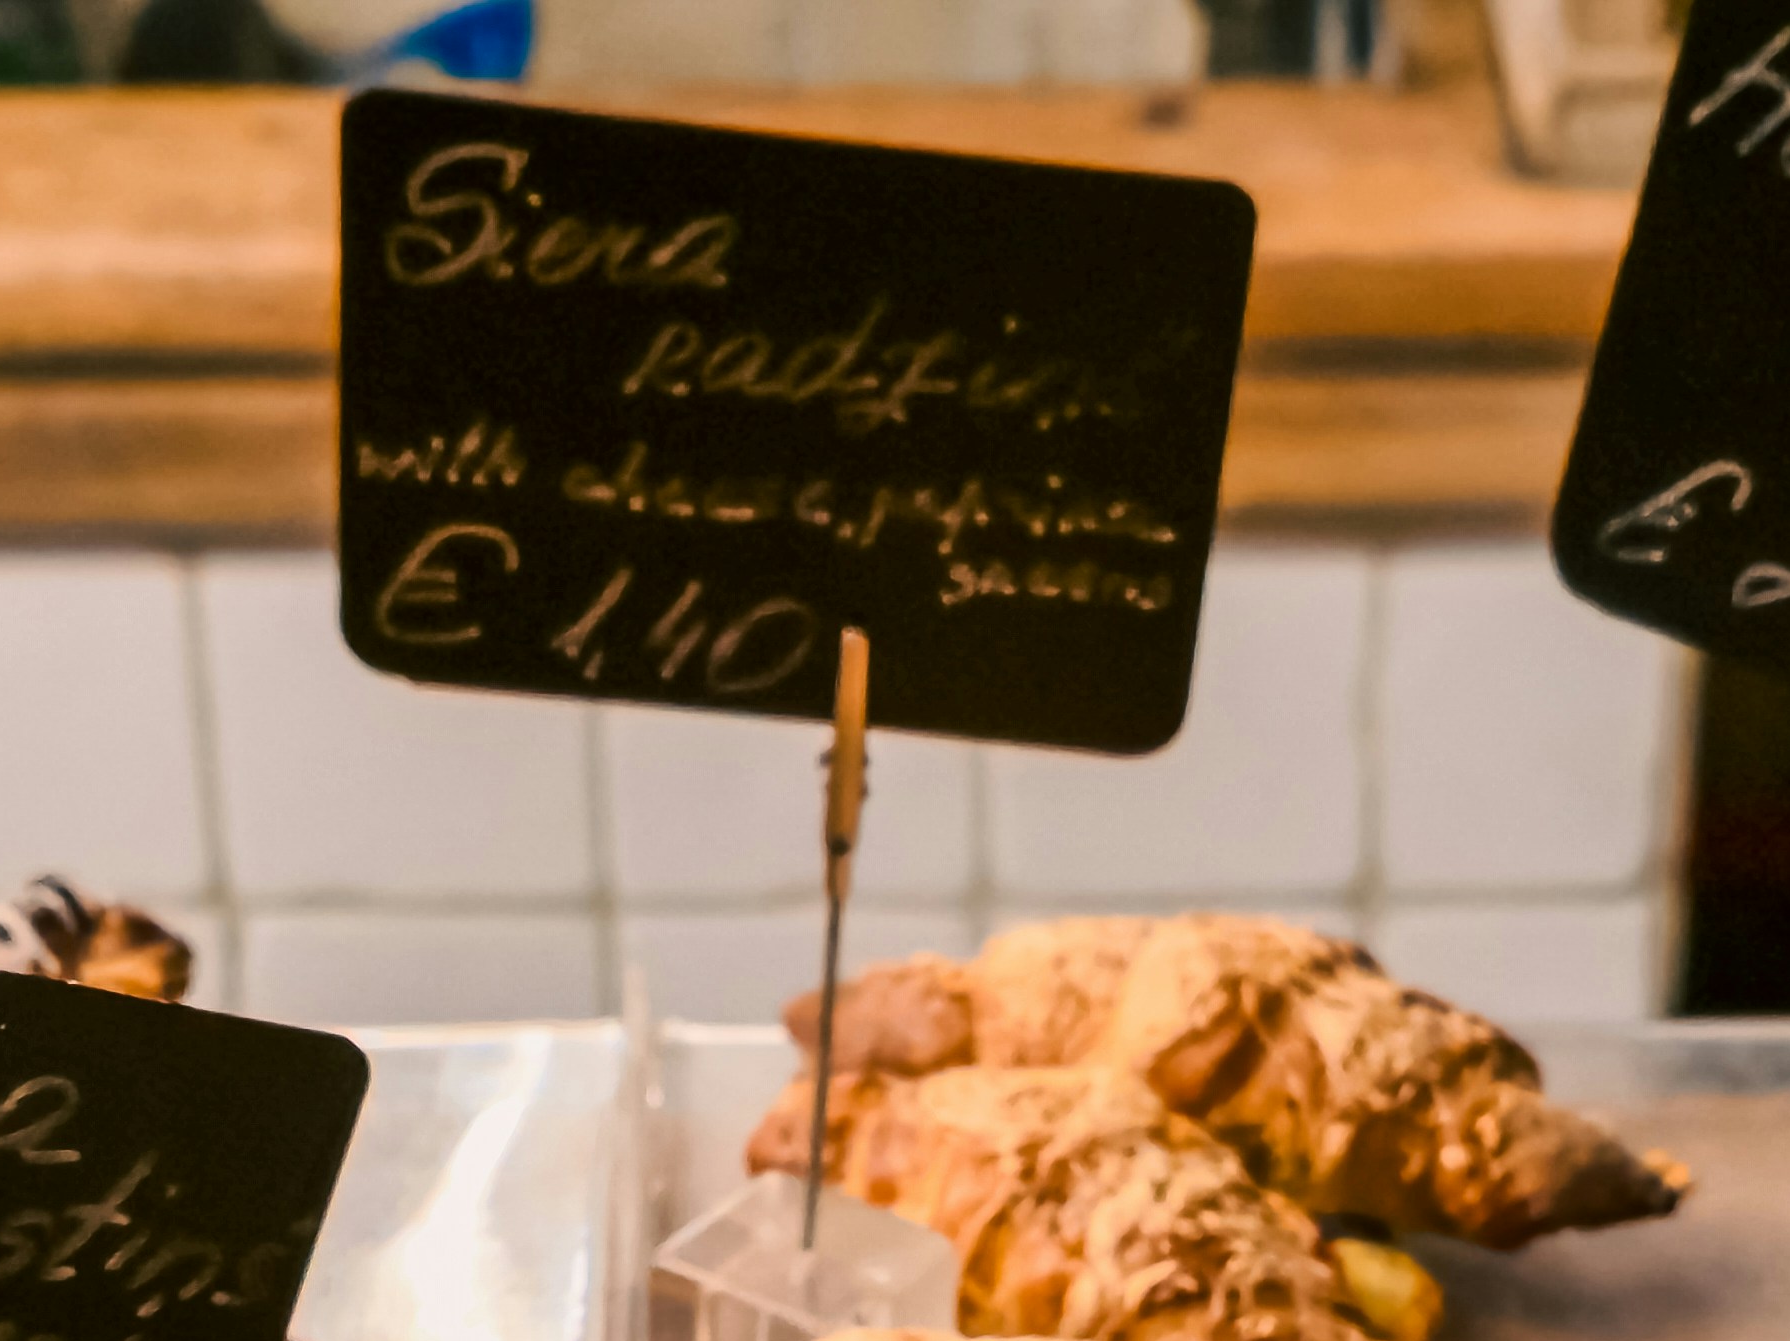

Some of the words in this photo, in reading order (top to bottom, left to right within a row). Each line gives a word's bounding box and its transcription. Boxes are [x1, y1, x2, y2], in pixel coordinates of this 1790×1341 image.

[383, 138, 736, 288] Siera
[355, 414, 528, 487] with
[374, 523, 519, 642] €
